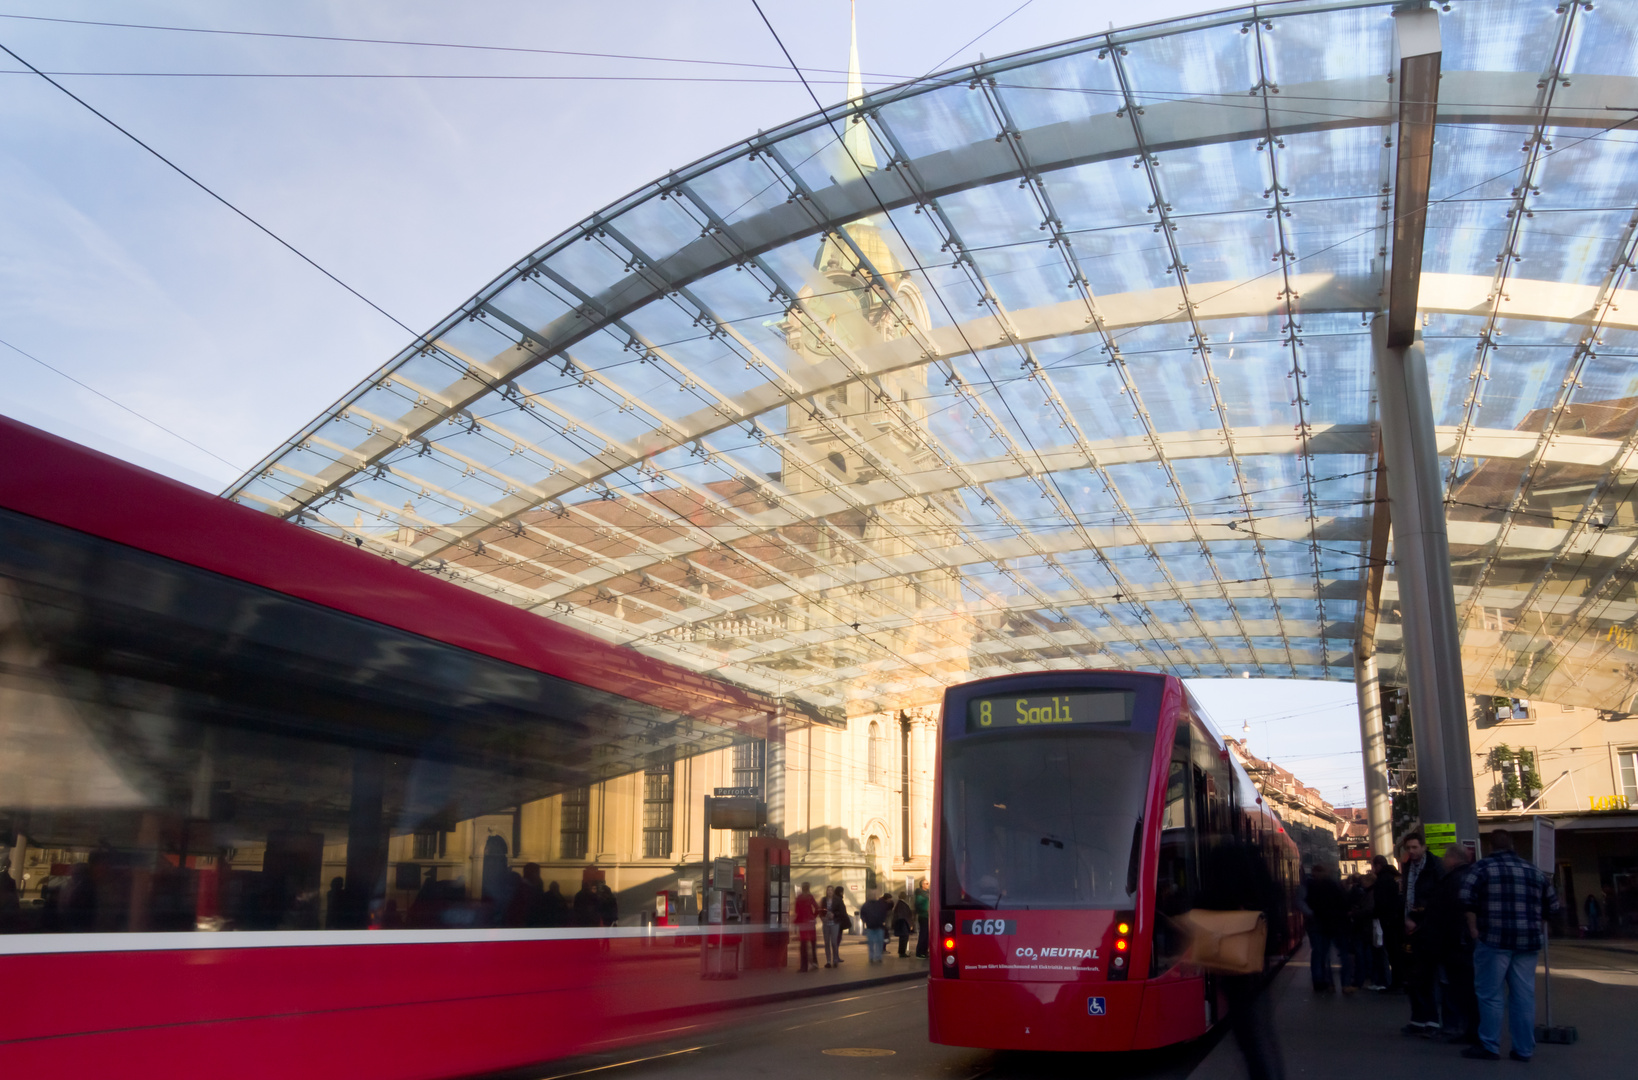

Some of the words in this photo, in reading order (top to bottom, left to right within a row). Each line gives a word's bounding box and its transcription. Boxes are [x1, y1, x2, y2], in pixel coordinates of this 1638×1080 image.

[980, 700, 992, 726] 8
[1016, 696, 1073, 724] Saali
[748, 787, 754, 795] C
[1588, 795, 1630, 811] LOEB
[971, 918, 1006, 936] 669
[1040, 947, 1100, 959] NEUTRAL
